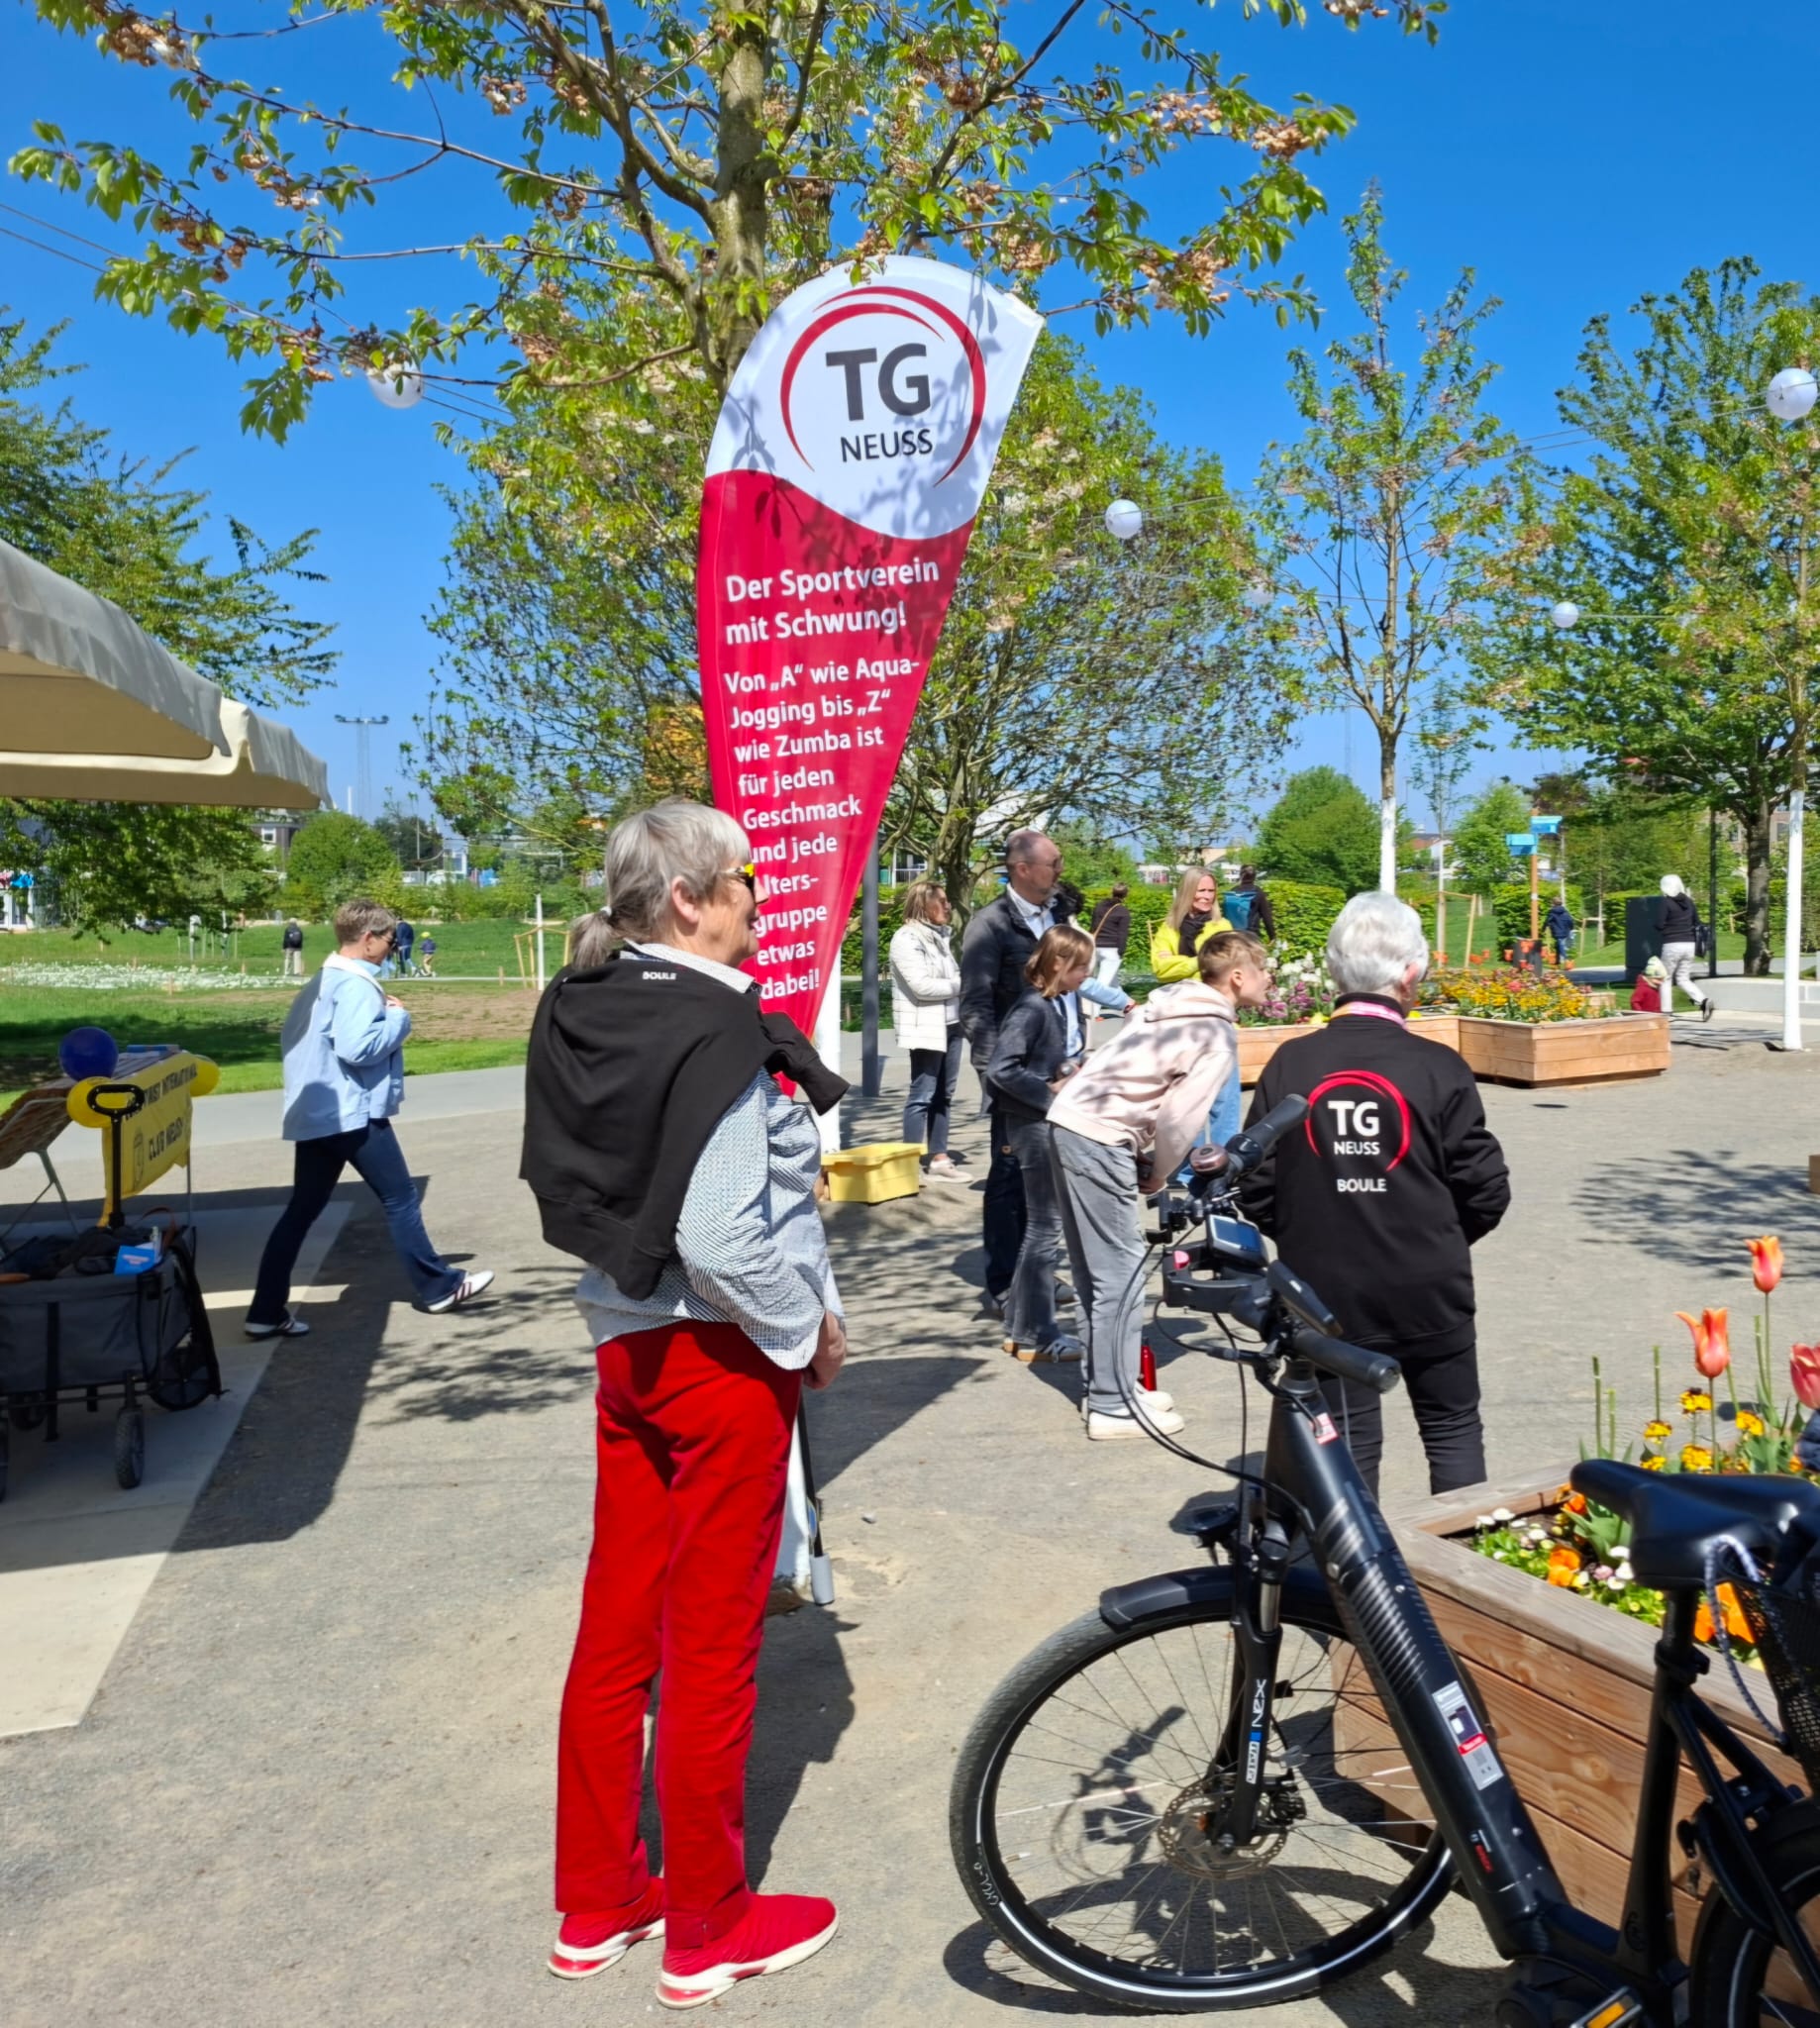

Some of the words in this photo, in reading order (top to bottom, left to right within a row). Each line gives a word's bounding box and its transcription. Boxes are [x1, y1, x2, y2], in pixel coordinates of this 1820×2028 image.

[826, 343, 931, 422] TG
[841, 429, 933, 462] NEUSS
[727, 574, 772, 602] Der
[779, 557, 940, 601] Sportverein
[726, 616, 769, 644] mit
[775, 601, 907, 639] Schwung!
[724, 672, 766, 693] Von
[810, 660, 850, 684] wie
[856, 658, 920, 683] Aqua-
[730, 700, 816, 731] Jogging
[821, 695, 853, 718] bis
[734, 739, 771, 762] wie
[774, 729, 852, 757] Zumba
[857, 726, 884, 748] ist
[738, 774, 767, 796] für
[772, 766, 835, 797] jeden
[744, 794, 862, 830] Geschmack
[791, 832, 838, 863] jede
[753, 905, 828, 938] gruppe
[757, 940, 815, 966] etwas
[642, 970, 677, 980] BOULE
[760, 967, 820, 1000] dabei!
[1327, 1100, 1379, 1137] TG
[1334, 1142, 1380, 1155] NEUSS
[1337, 1178, 1387, 1192] BOULE
